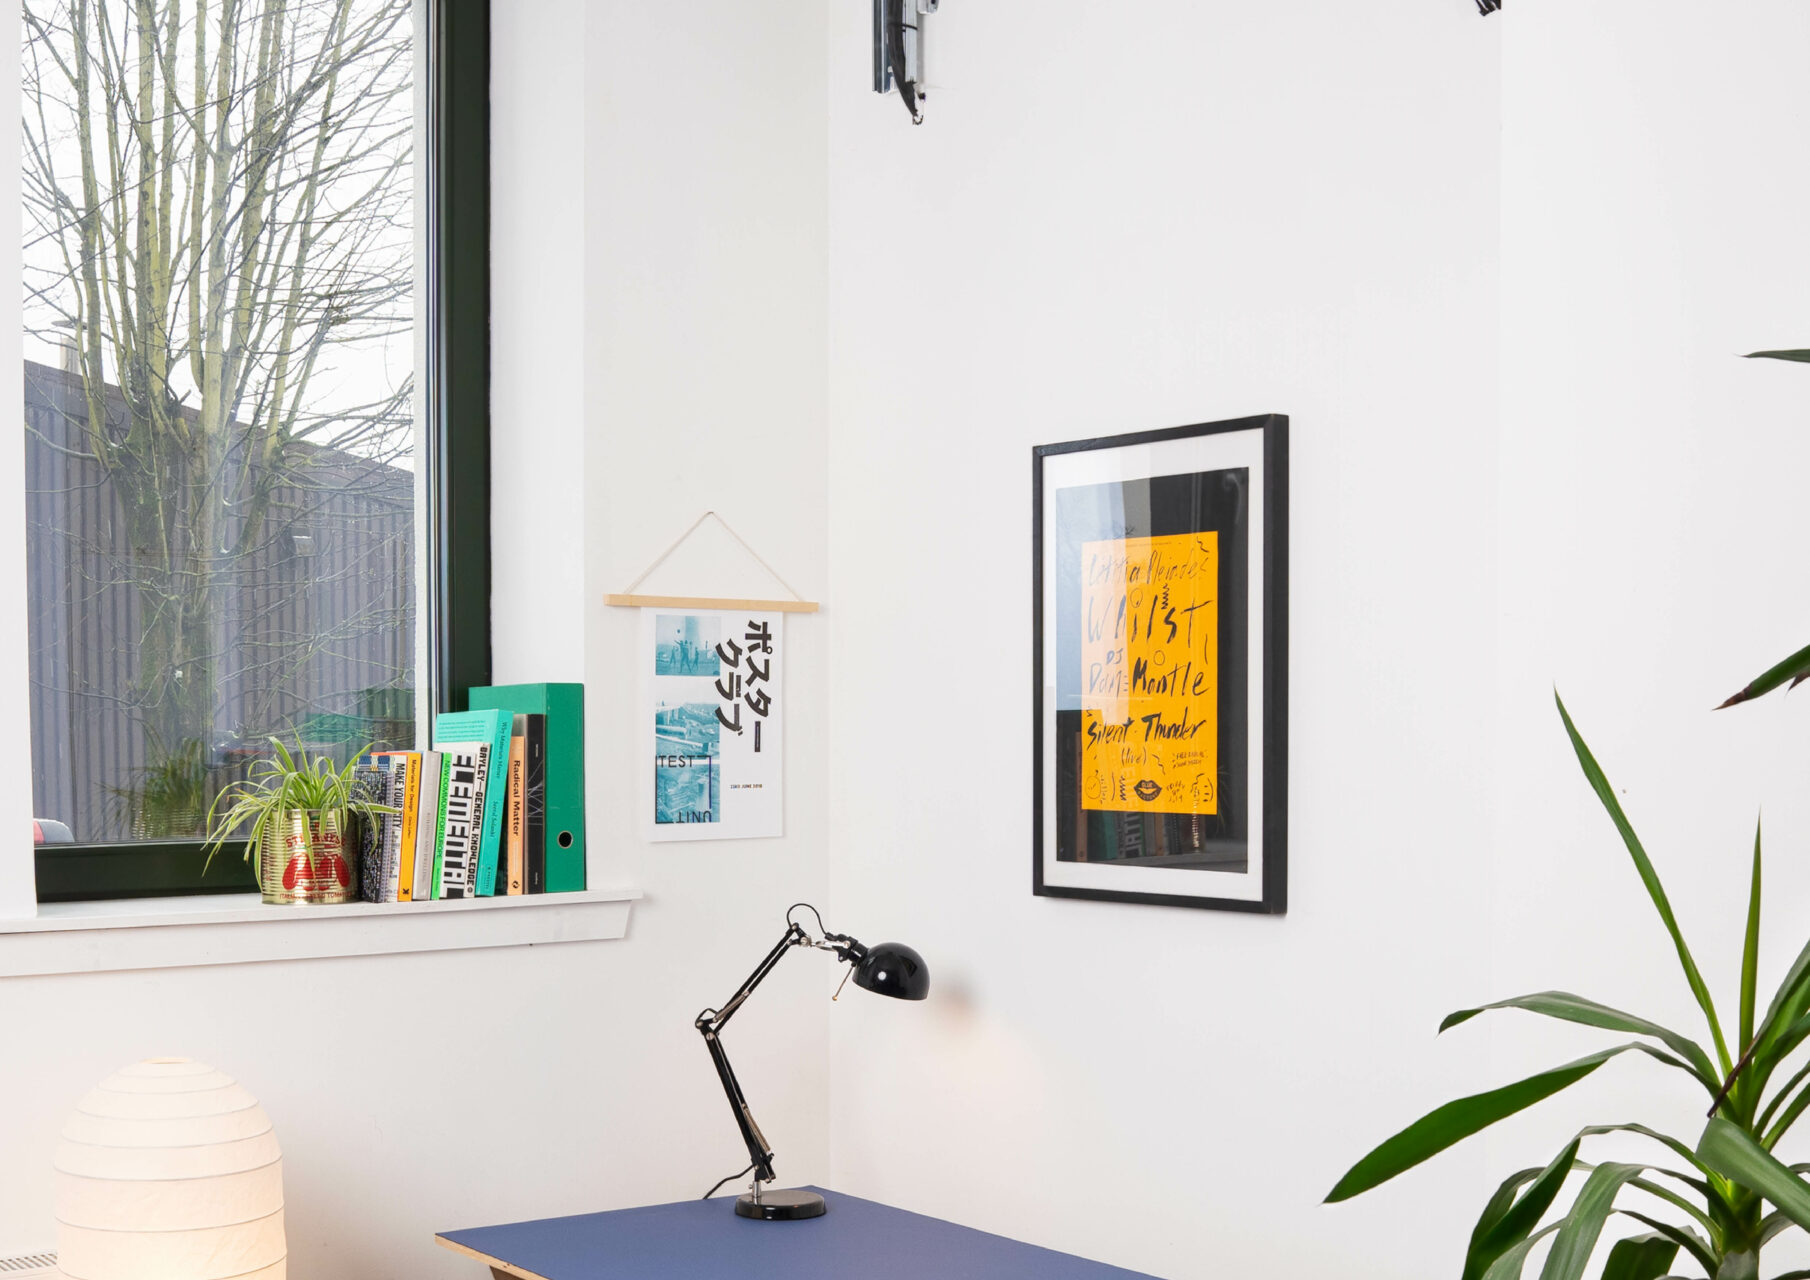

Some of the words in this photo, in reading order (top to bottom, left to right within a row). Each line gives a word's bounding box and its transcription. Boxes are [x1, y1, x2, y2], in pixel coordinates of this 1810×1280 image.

[1088, 594, 1215, 649] Whilst
[1106, 648, 1124, 665] DJ
[714, 638, 743, 736] クラブ
[745, 619, 773, 753] ポスター
[1132, 656, 1210, 697] Mantle
[1086, 717, 1136, 751] Silent
[1141, 706, 1207, 742] Thunder
[395, 762, 406, 785] MAKE
[409, 759, 417, 784] Materials
[443, 760, 451, 777] NEW
[658, 755, 695, 768] TEST
[513, 760, 521, 798] Radical
[393, 787, 404, 809] YOUR
[439, 778, 449, 816] COMMONS
[391, 811, 403, 829] CITY
[438, 817, 446, 832] FOR
[439, 754, 475, 899] ELEMENTAL
[512, 801, 521, 836] Matter
[676, 810, 712, 824] UNIT
[436, 832, 445, 859] EUROPE
[466, 833, 480, 886] KNOWLEDGE
